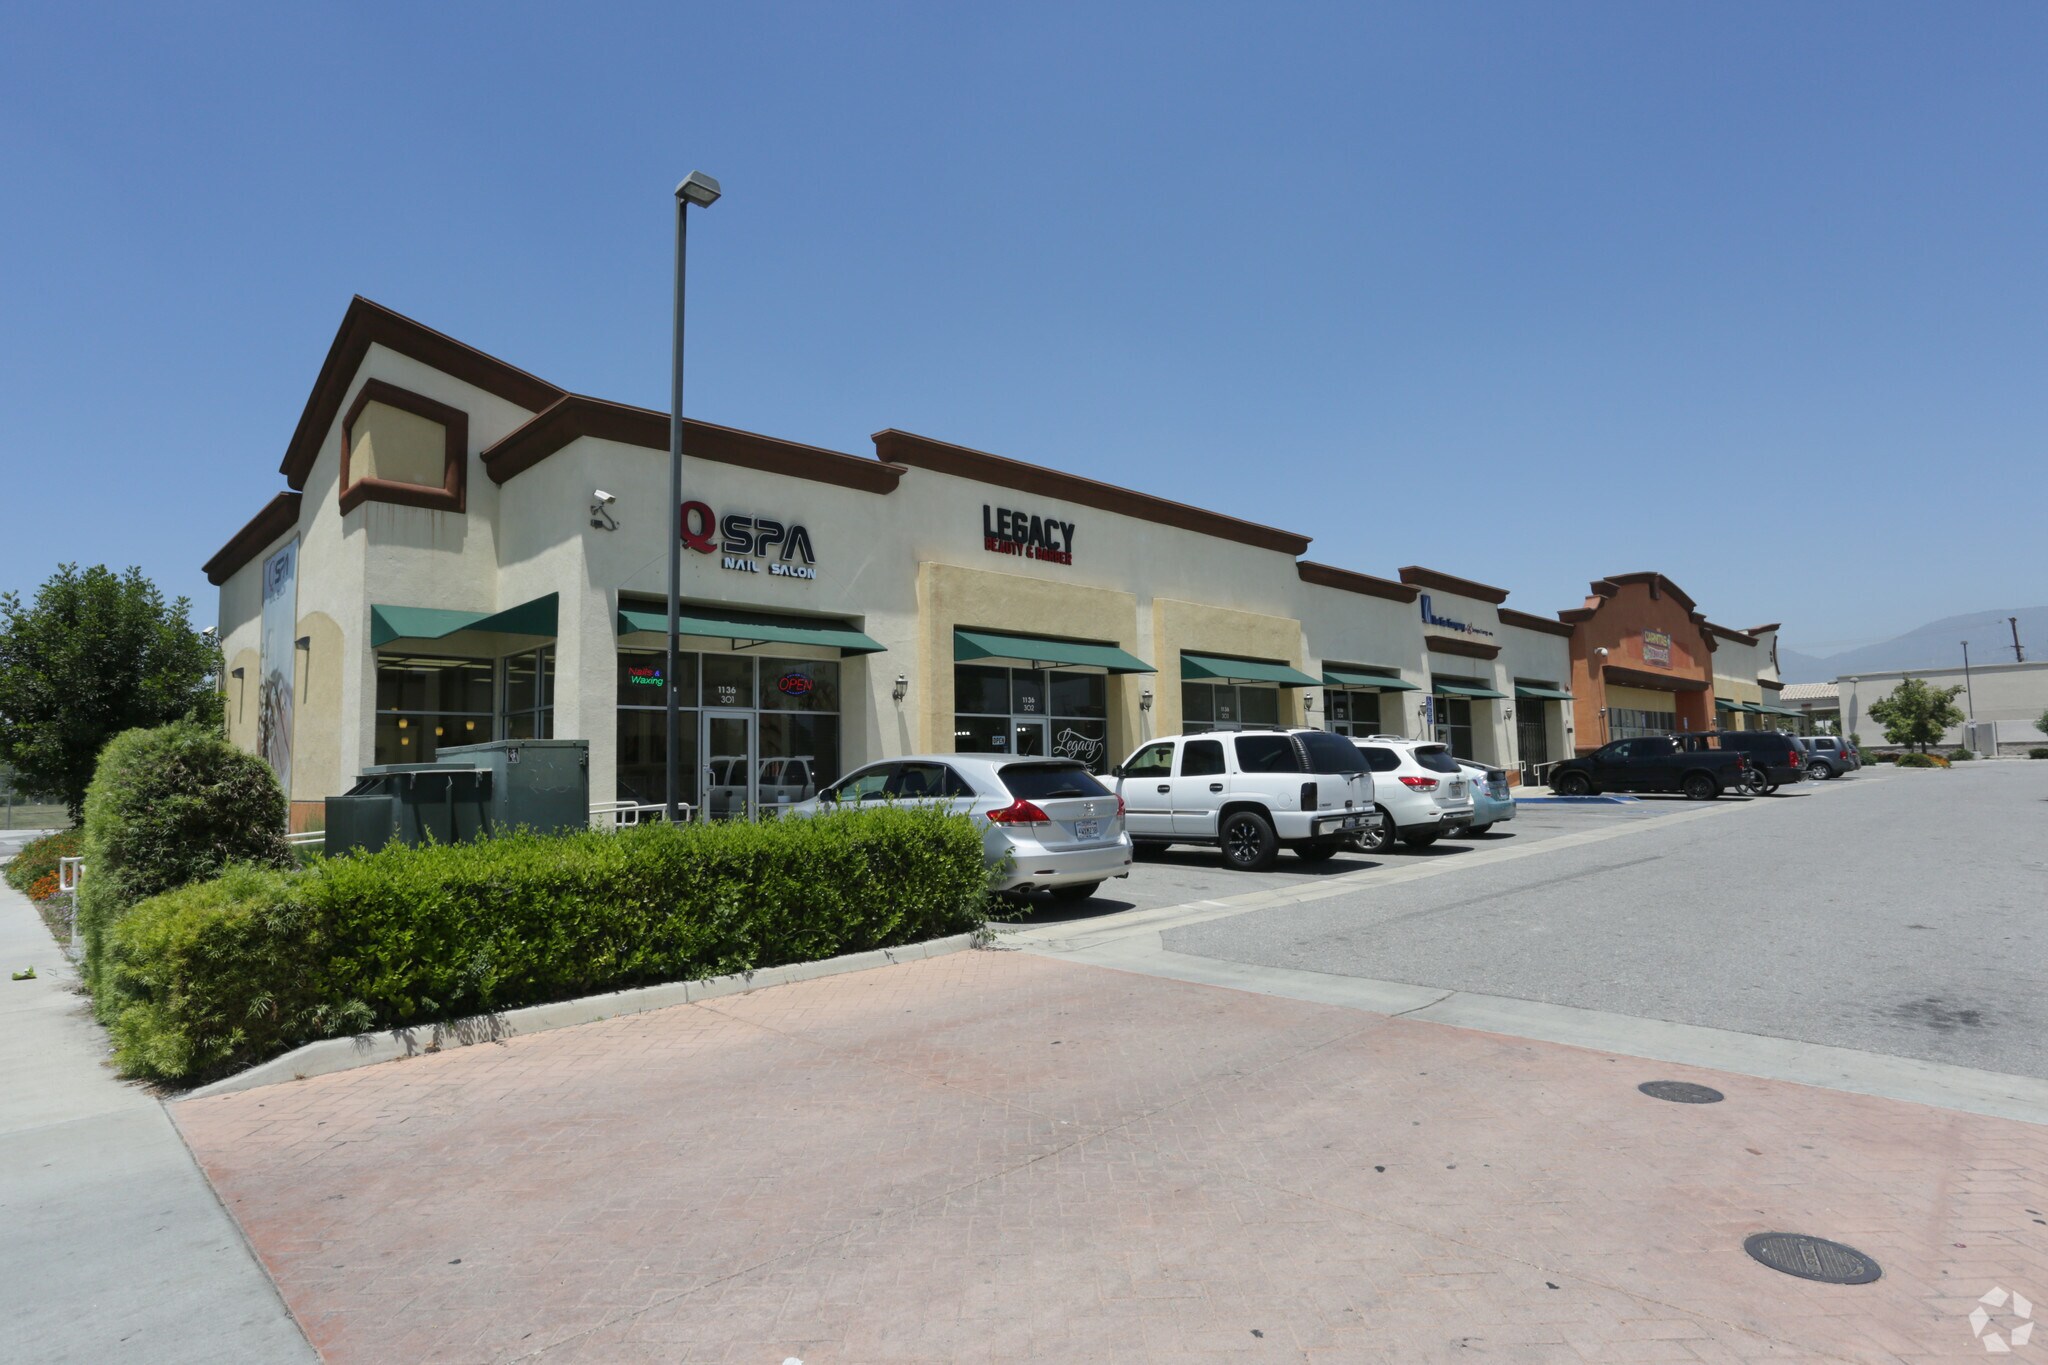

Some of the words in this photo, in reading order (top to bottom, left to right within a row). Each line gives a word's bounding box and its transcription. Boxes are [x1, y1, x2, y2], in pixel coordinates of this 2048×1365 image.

[983, 505, 1075, 553] LEGACY
[720, 514, 816, 564] SPA
[984, 537, 1023, 556] BEAUTY
[1025, 545, 1034, 559] &
[1035, 546, 1072, 565] BARBER
[721, 556, 760, 573] NAIL
[769, 563, 817, 580] SALON
[628, 667, 653, 676] Nails
[631, 675, 664, 687] Waxing
[717, 686, 737, 694] 1136
[779, 677, 813, 691] OPEN
[720, 695, 735, 704] 301
[1053, 727, 1103, 764] Legacy
